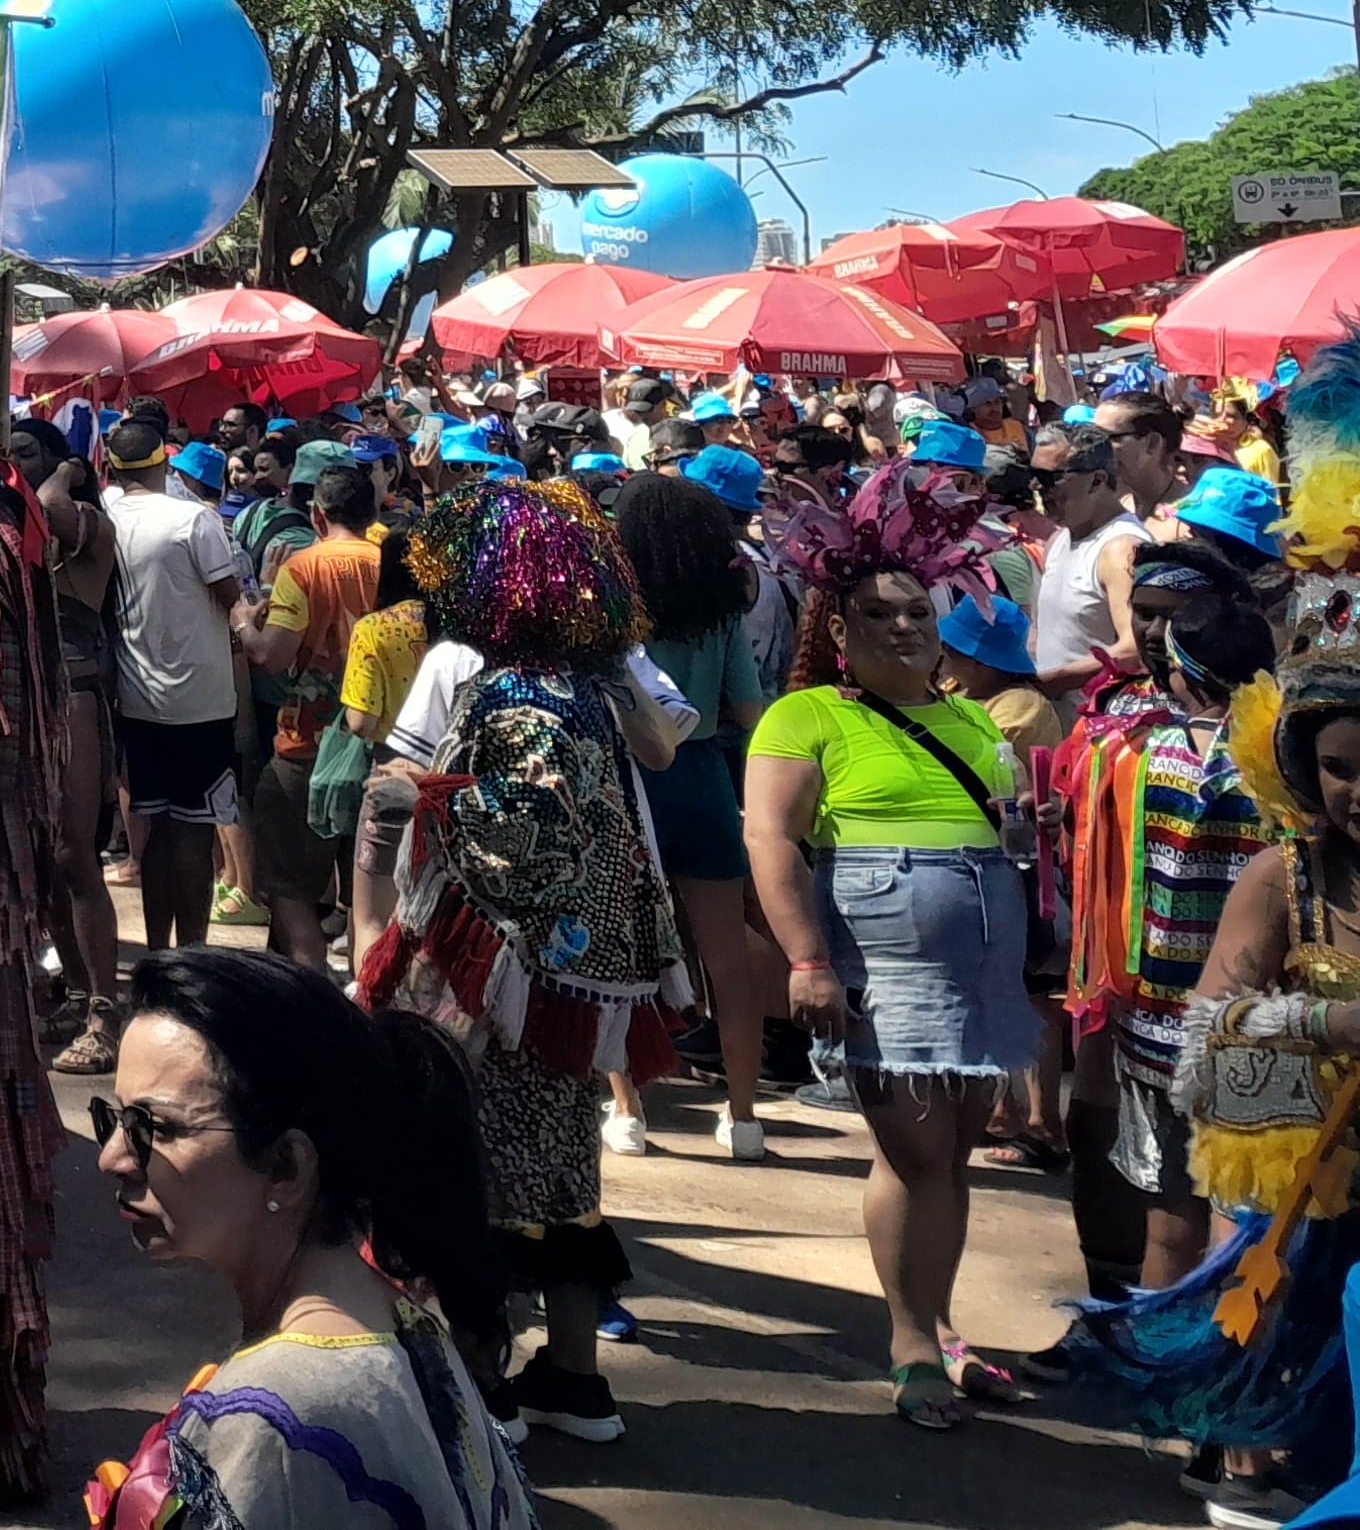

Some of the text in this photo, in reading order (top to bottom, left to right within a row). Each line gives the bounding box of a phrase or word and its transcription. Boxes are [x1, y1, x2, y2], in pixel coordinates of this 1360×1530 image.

[592, 242, 630, 261] pago
[834, 256, 879, 279] BRAHMA
[158, 318, 279, 359] BRAHMA
[780, 352, 847, 375] BRAHMA
[1168, 933, 1191, 946] DO
